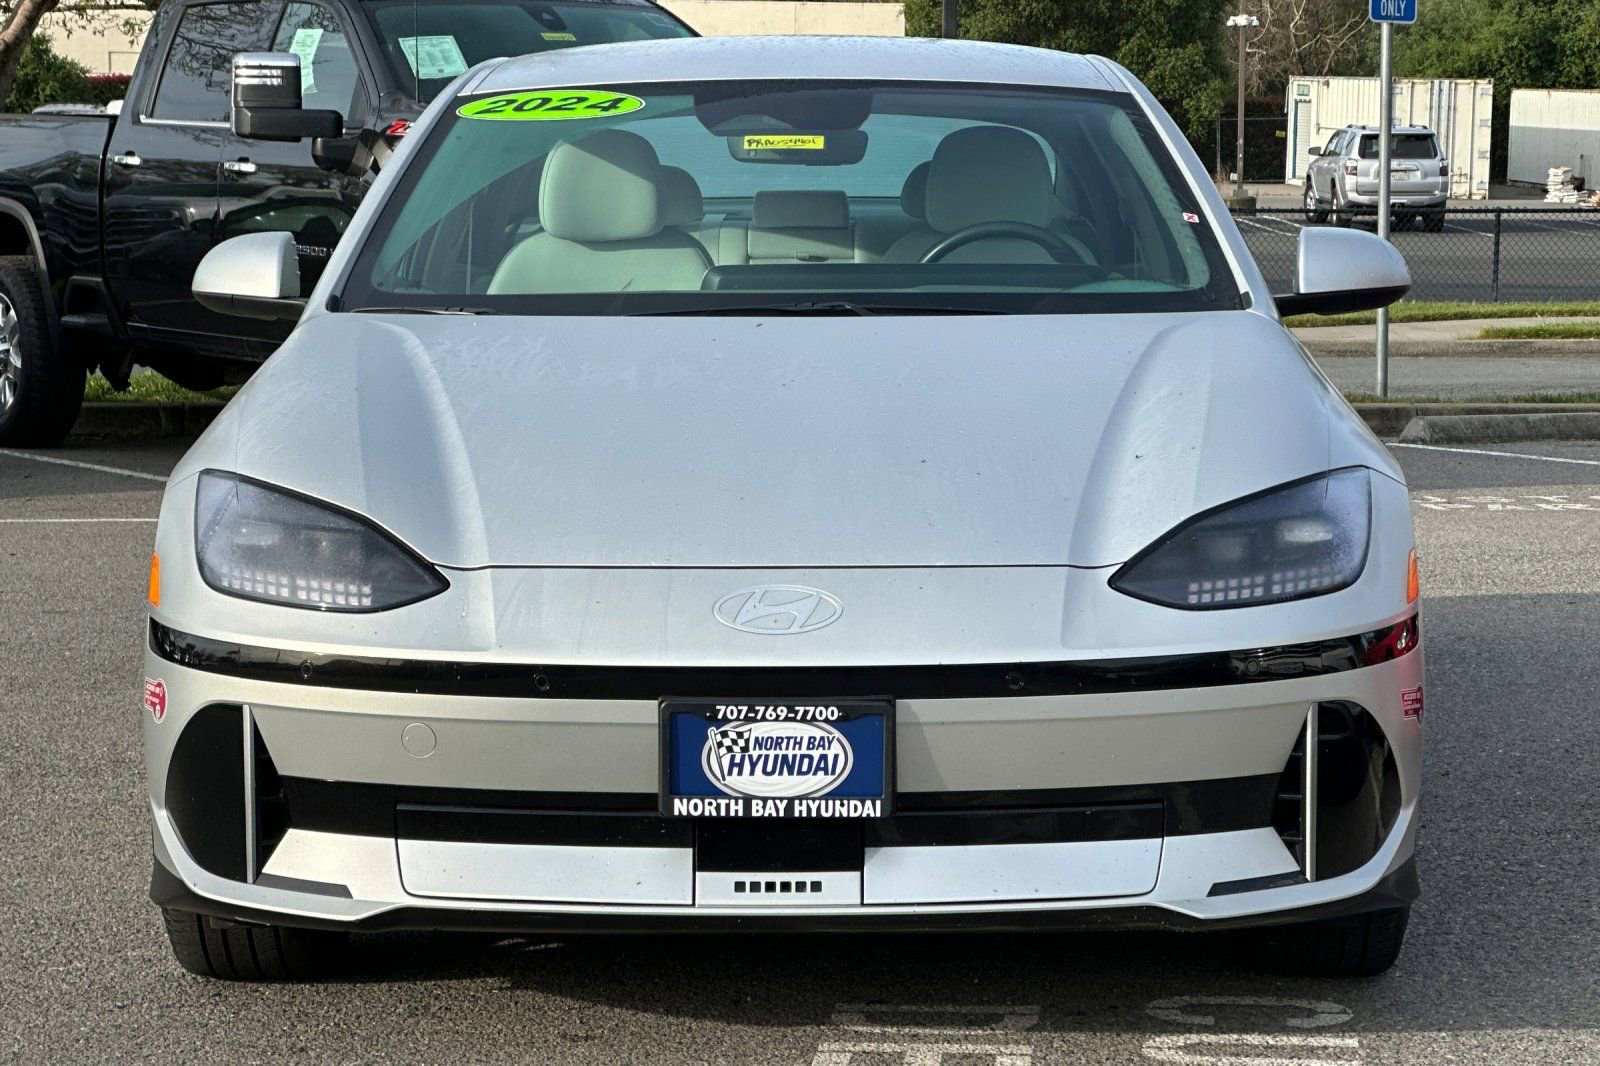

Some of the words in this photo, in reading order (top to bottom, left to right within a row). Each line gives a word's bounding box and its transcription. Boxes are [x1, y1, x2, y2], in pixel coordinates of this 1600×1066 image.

[1380, 0, 1407, 17] ONLY
[471, 95, 628, 117] 2024
[715, 705, 839, 721] 707-769-7700
[753, 735, 801, 751] NORTH
[806, 735, 836, 751] BAY
[727, 752, 840, 777] HYUNDAI
[673, 798, 744, 817] NORTH
[751, 799, 789, 818] BAY
[794, 799, 882, 818] HYUNDAI
